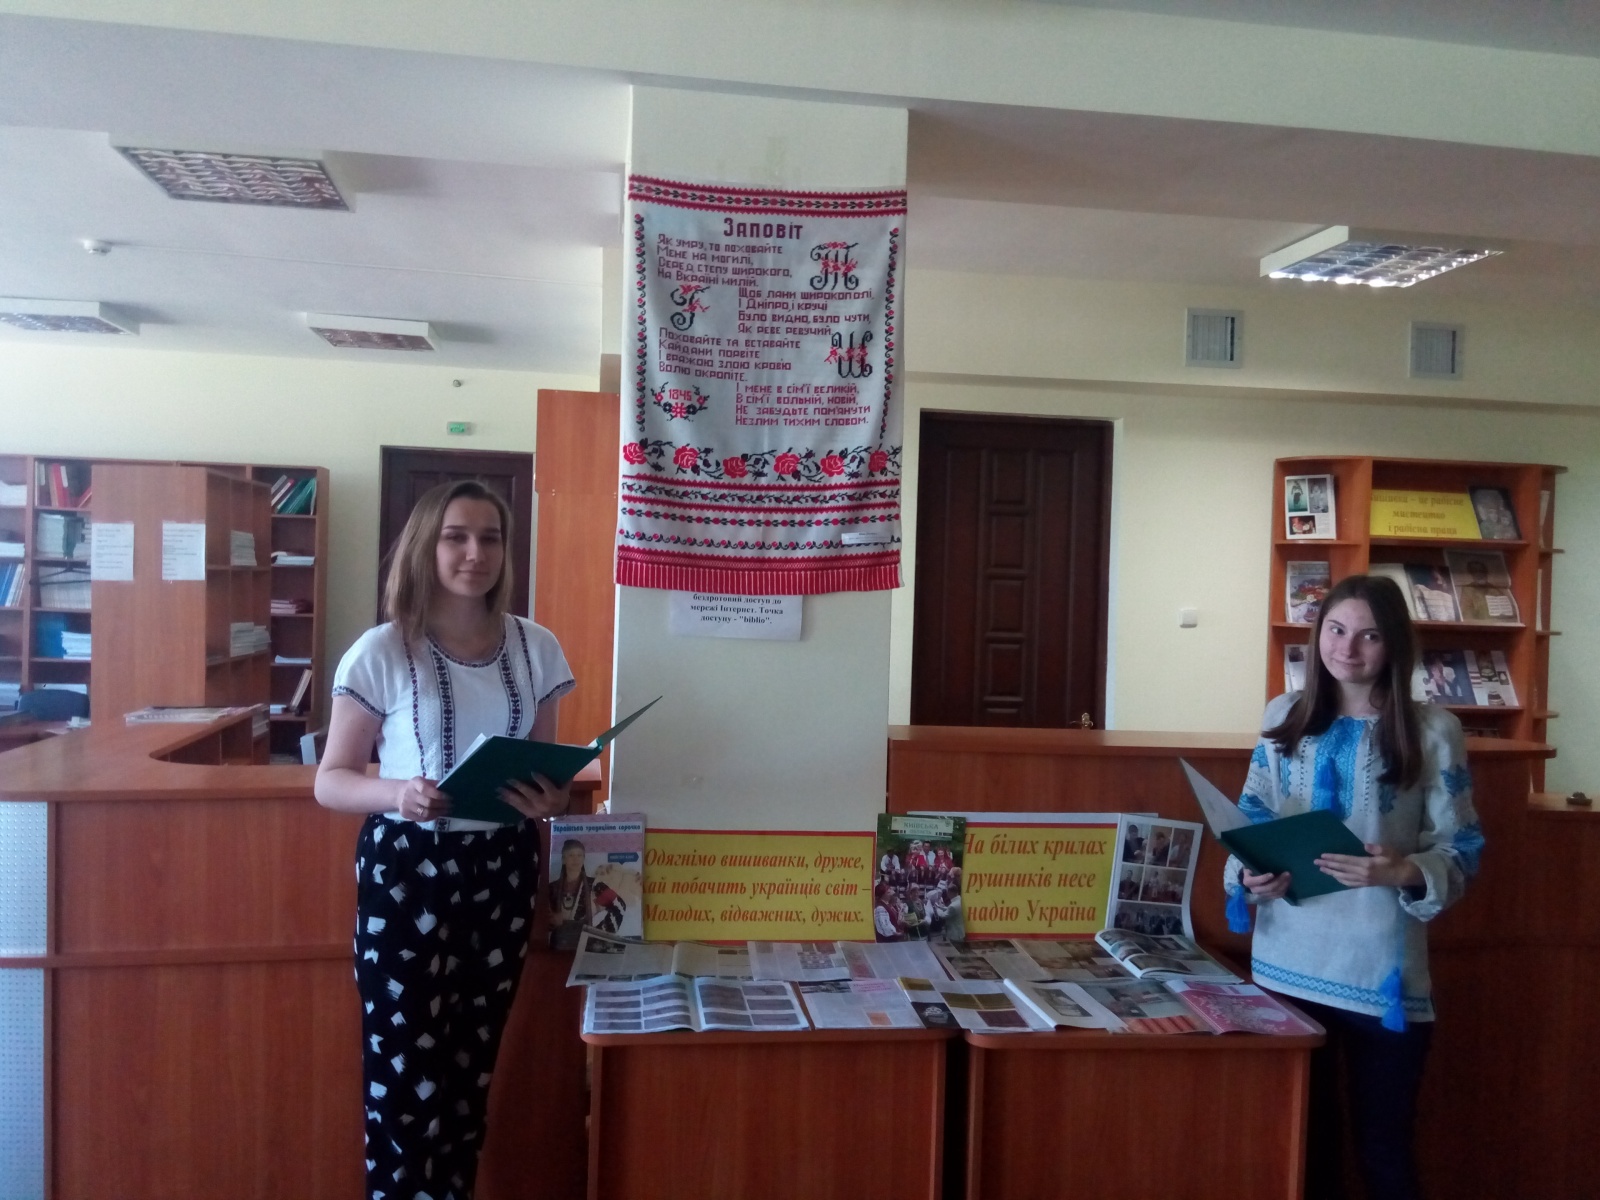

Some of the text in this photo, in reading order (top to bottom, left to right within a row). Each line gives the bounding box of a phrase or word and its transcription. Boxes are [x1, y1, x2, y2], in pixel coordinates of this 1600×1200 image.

[724, 217, 803, 240] Заповіт
[657, 234, 673, 246] Як
[709, 242, 721, 251] то
[724, 243, 783, 255] поховайте
[657, 245, 687, 259] Мене
[692, 252, 707, 261] на
[658, 256, 793, 278] Серед степу широкого,
[657, 267, 759, 287] На Вкраїні милій.
[738, 288, 762, 299] Щоб
[767, 290, 796, 299] лани
[739, 298, 742, 308] І
[792, 300, 795, 310] і
[797, 301, 828, 311] кручі
[738, 310, 872, 325] Було видно, було чути,
[659, 327, 800, 349] Поховайте та вставайте
[738, 323, 834, 336] Як реве ревучий.
[659, 339, 760, 359] Кайдани порвіте
[659, 350, 662, 360] І
[666, 354, 713, 368] вражою
[718, 360, 749, 369] злою
[659, 361, 748, 382] Волю окропіте.
[669, 389, 692, 401] 1845
[736, 382, 739, 392] І
[745, 385, 772, 394] мене
[814, 383, 859, 394] великій,
[736, 393, 743, 403] В
[777, 394, 824, 406] вольній,
[828, 394, 858, 405] новій,
[736, 405, 748, 415] Не
[756, 407, 808, 417] забудьте
[784, 418, 820, 426] тихим
[825, 417, 869, 426] словом.
[693, 594, 742, 603] бездротовий
[744, 597, 770, 605] доступ
[720, 605, 757, 614] Інтернет.
[760, 607, 783, 615] Точка
[740, 616, 772, 624] "biblio".
[964, 833, 1107, 861] На білих крилах
[645, 849, 864, 873] Одягнімо вишиванки, друже,
[671, 877, 746, 894] побачить
[750, 878, 821, 899] українців
[825, 879, 858, 895] світ
[965, 867, 1096, 893] рушників несе
[644, 904, 864, 926] Молодих, відважних, дужих.
[968, 900, 1096, 928] надію Україна
